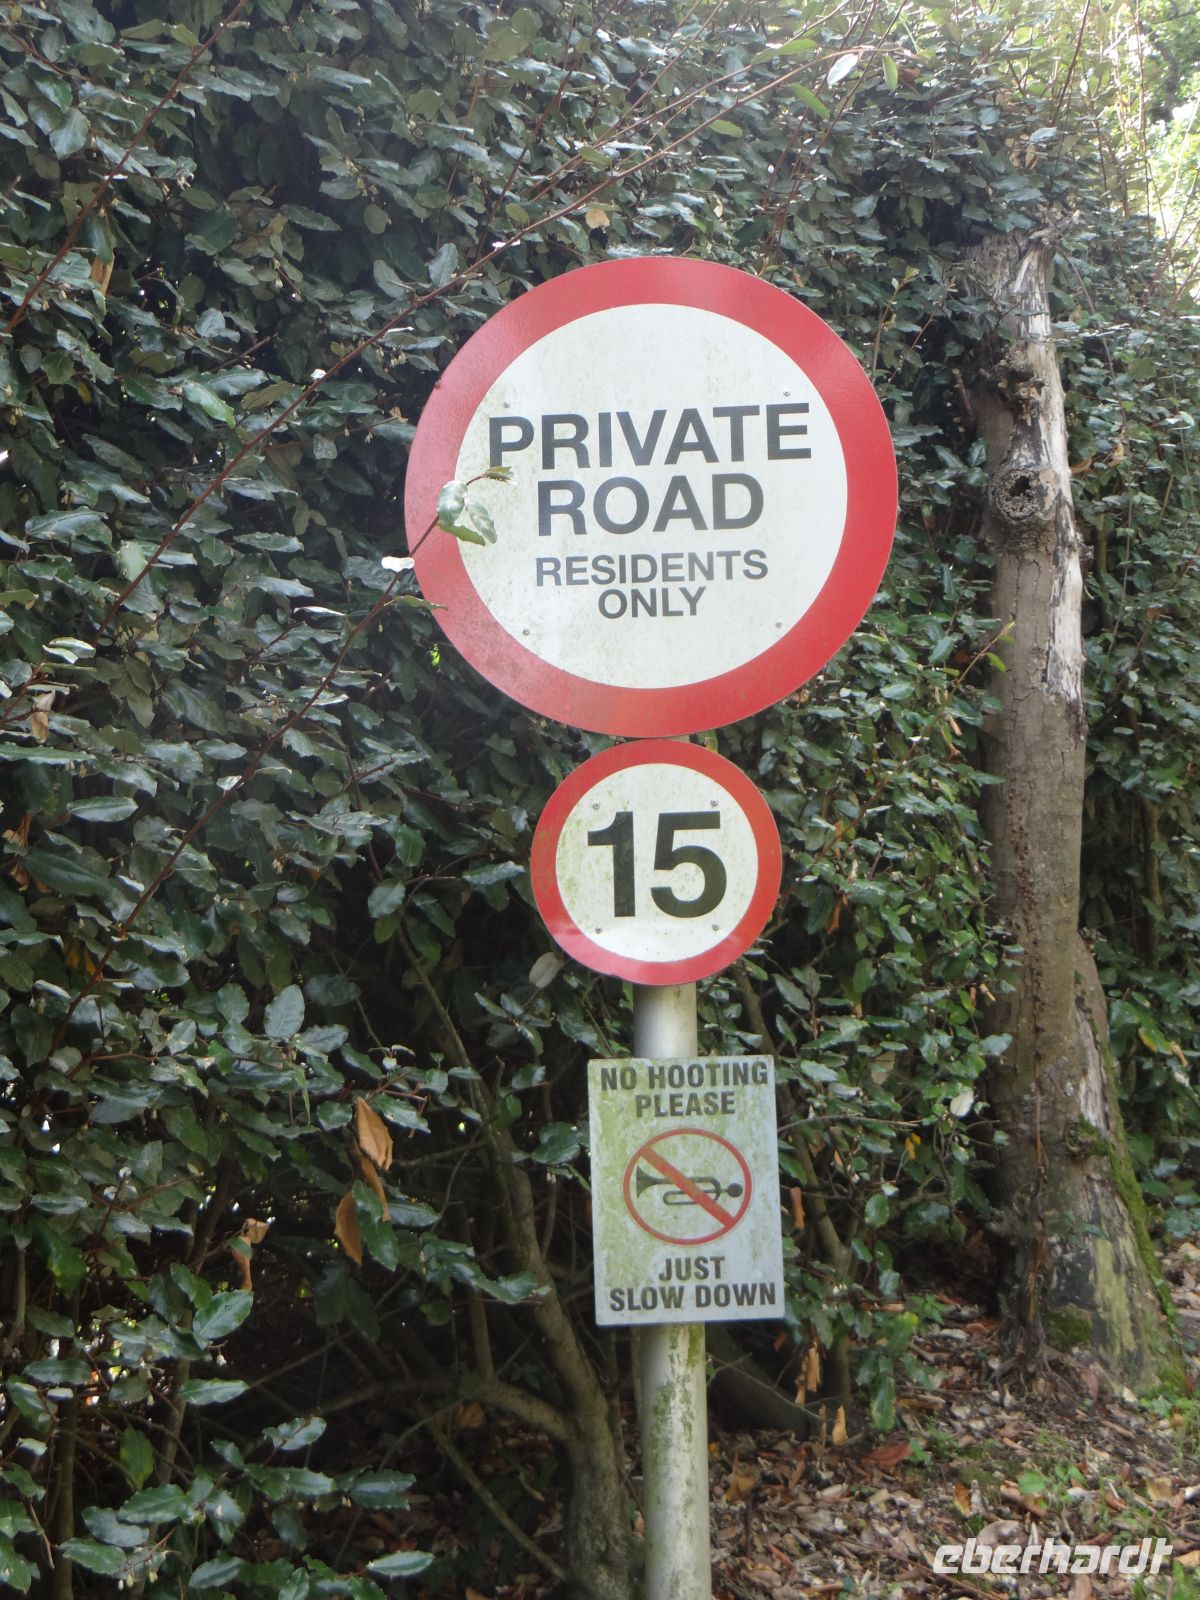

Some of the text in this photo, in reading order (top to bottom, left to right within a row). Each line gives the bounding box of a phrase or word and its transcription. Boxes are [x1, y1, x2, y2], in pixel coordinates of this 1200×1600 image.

[489, 402, 811, 470] PRIVATE
[538, 473, 764, 537] ROAD
[535, 549, 768, 587] RESIDENTS
[598, 586, 706, 620] ONLY
[587, 811, 727, 918] 15
[601, 1061, 768, 1091] NO HOOTING
[636, 1091, 736, 1118] PLEASE
[658, 1256, 725, 1281] JUST
[610, 1282, 776, 1311] SLOW DOWN
